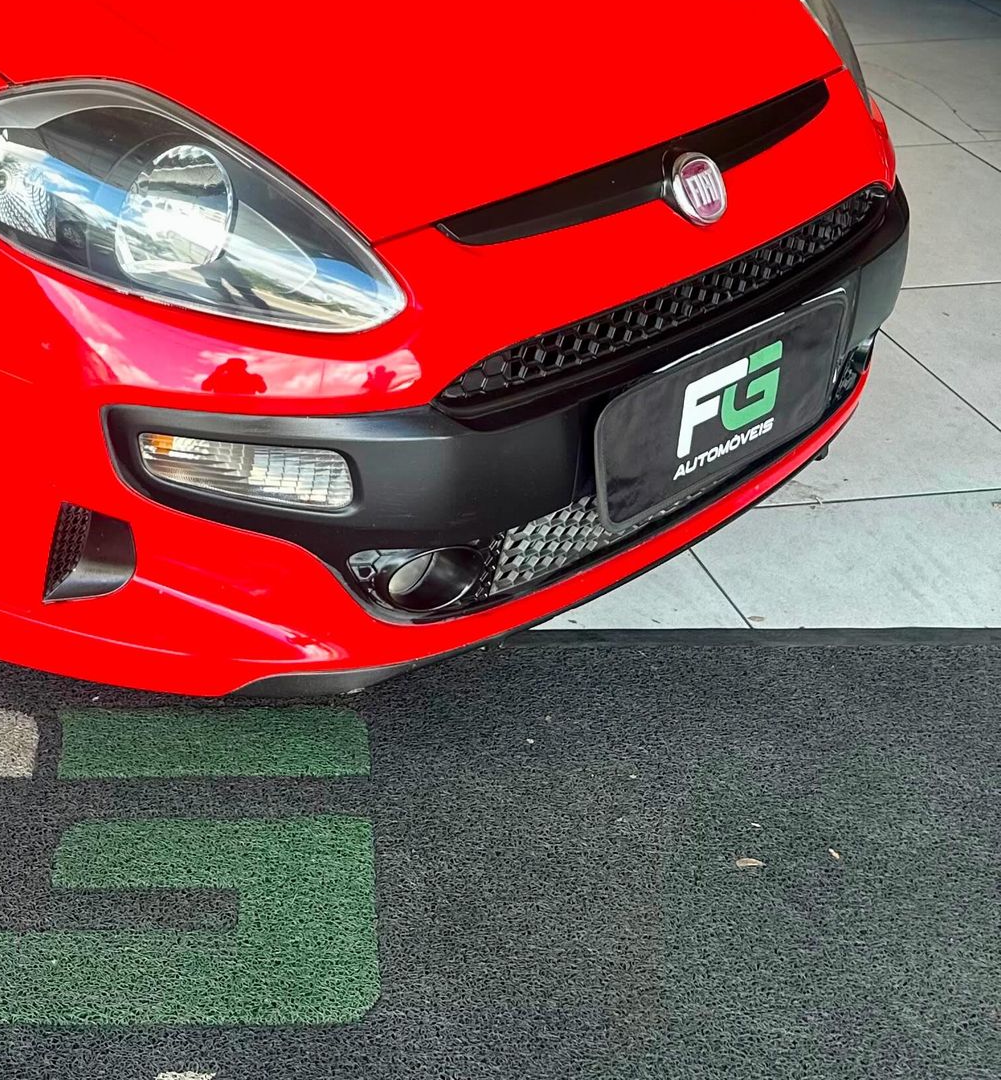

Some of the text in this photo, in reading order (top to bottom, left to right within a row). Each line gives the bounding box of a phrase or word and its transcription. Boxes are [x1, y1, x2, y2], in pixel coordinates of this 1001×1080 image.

[685, 170, 719, 209] FIAT
[676, 340, 783, 459] FG
[673, 417, 775, 480] AUTOMÓVEIS
